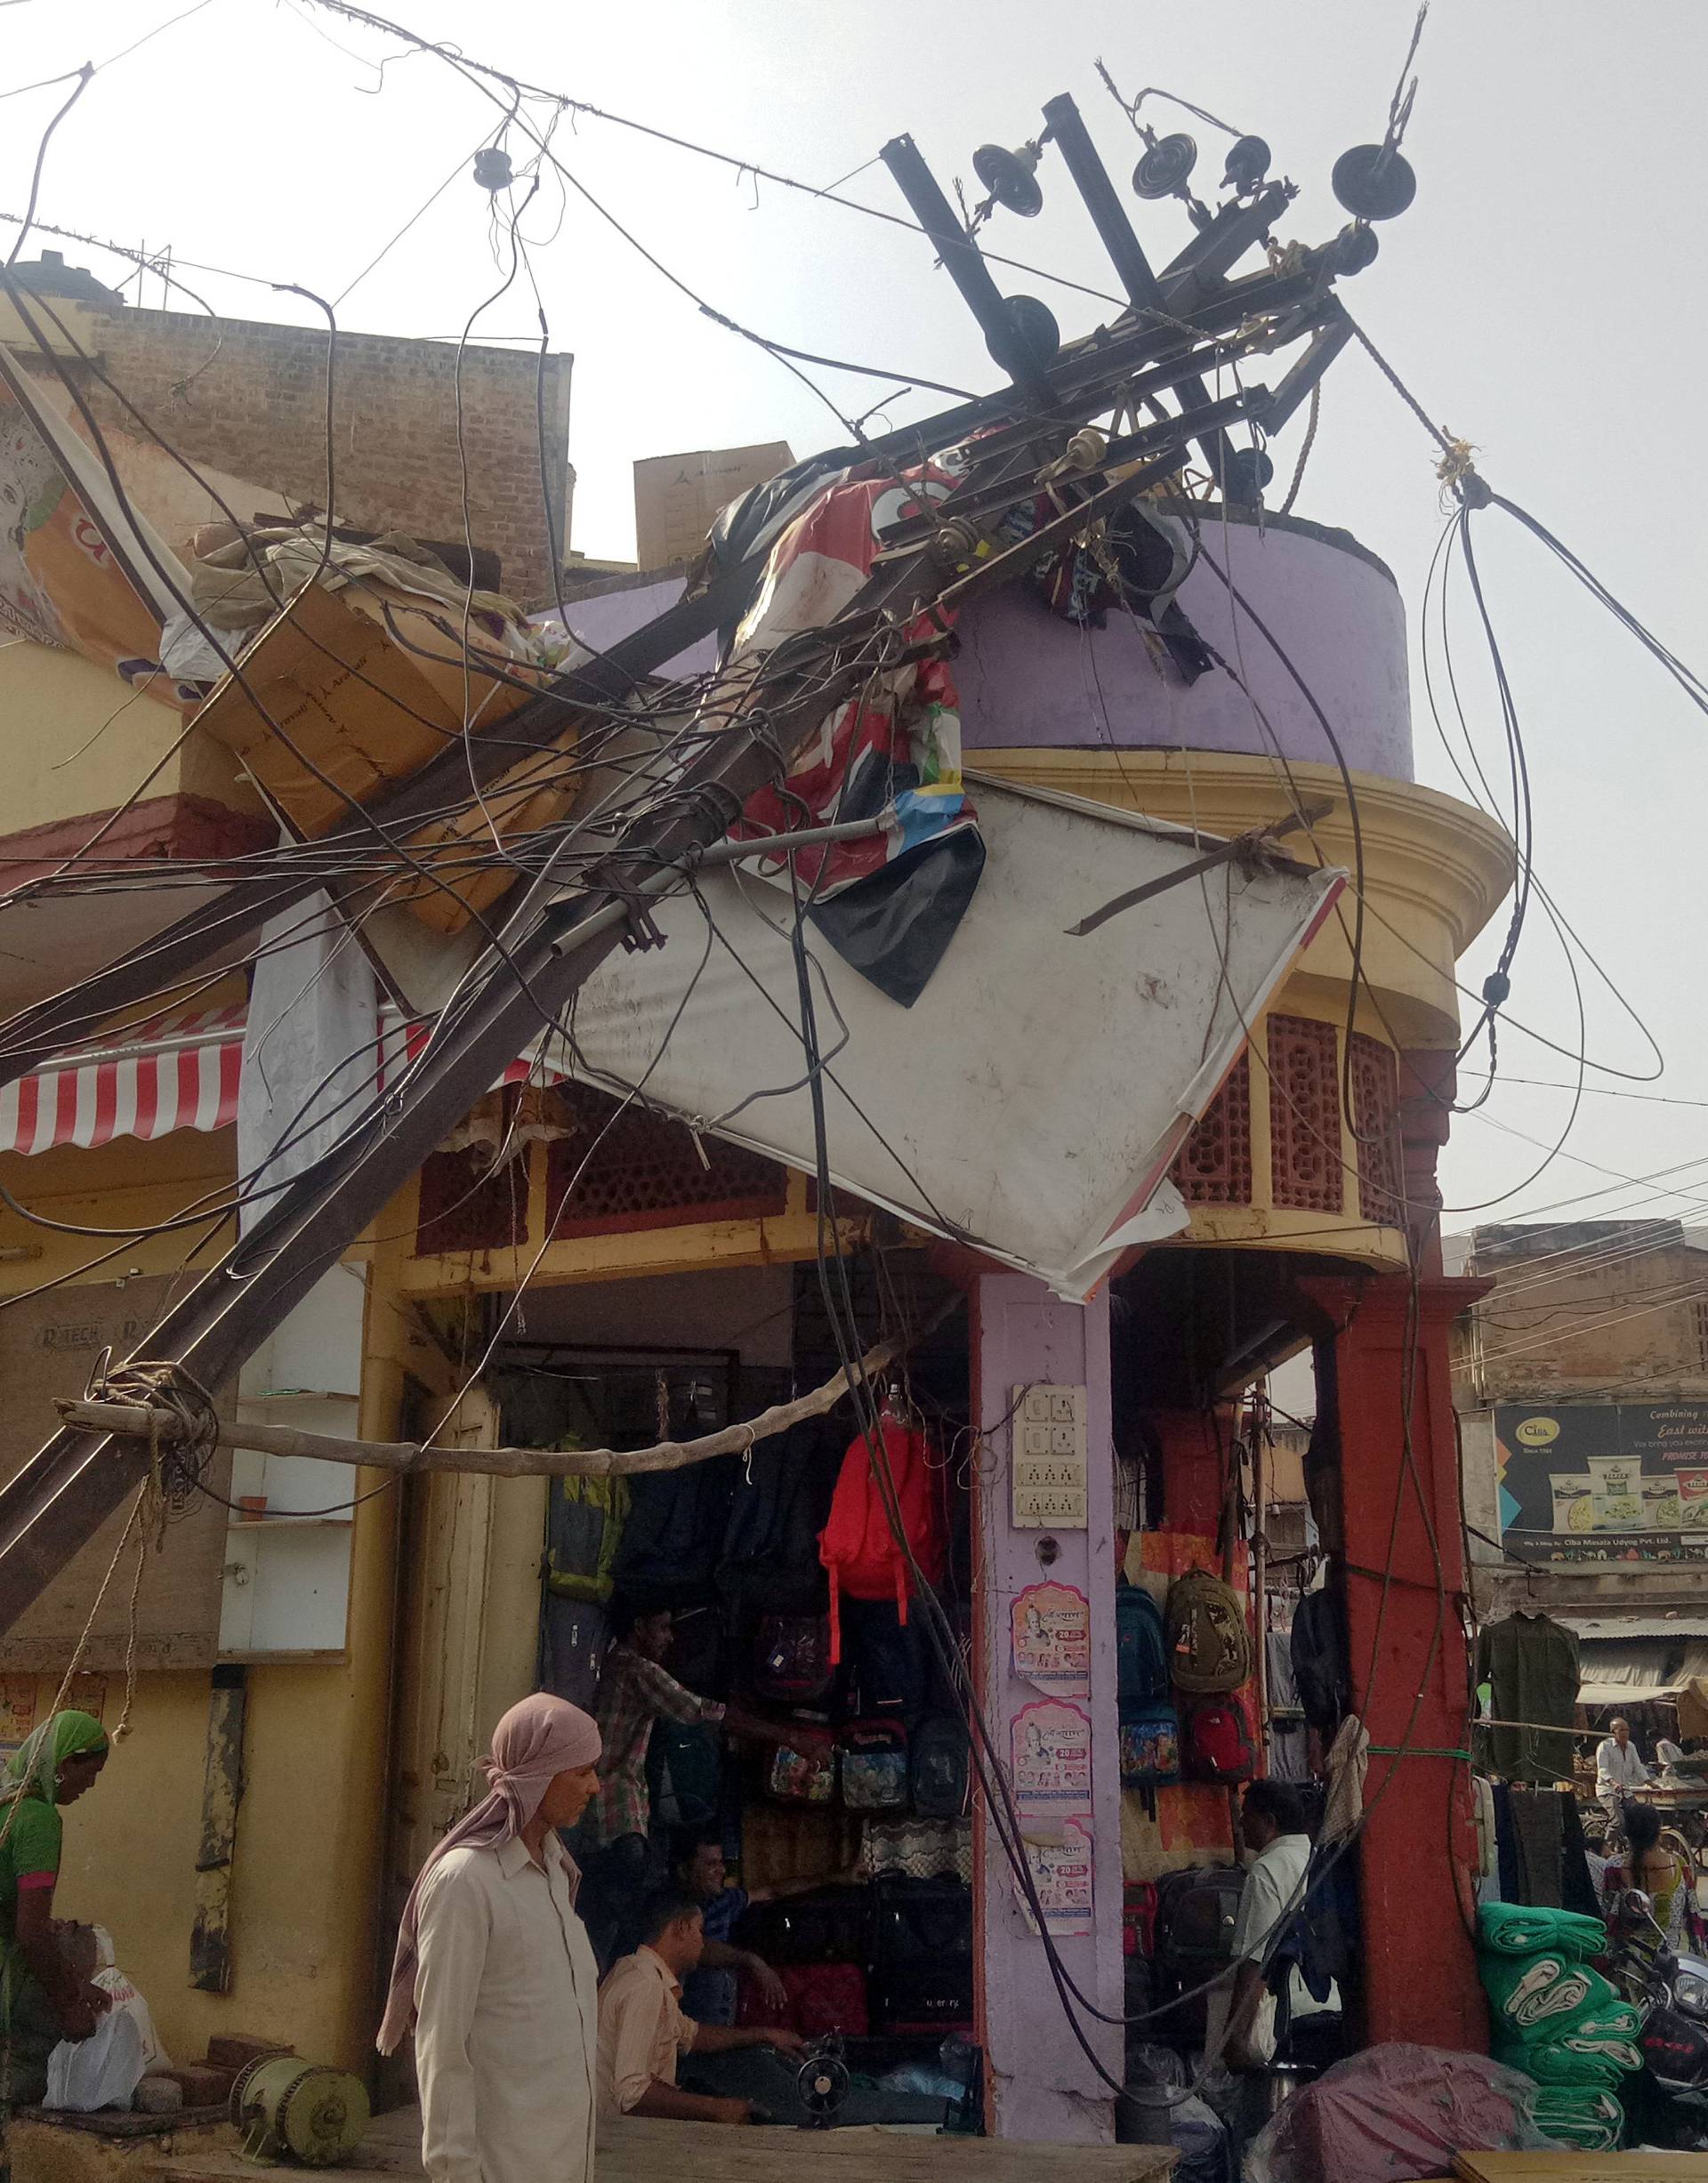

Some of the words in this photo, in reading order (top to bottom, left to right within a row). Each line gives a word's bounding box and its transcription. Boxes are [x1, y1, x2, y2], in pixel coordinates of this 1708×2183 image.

[1650, 1409, 1697, 1421] Combining
[1658, 1424, 1685, 1438] East
[1688, 1424, 1708, 1434] wit
